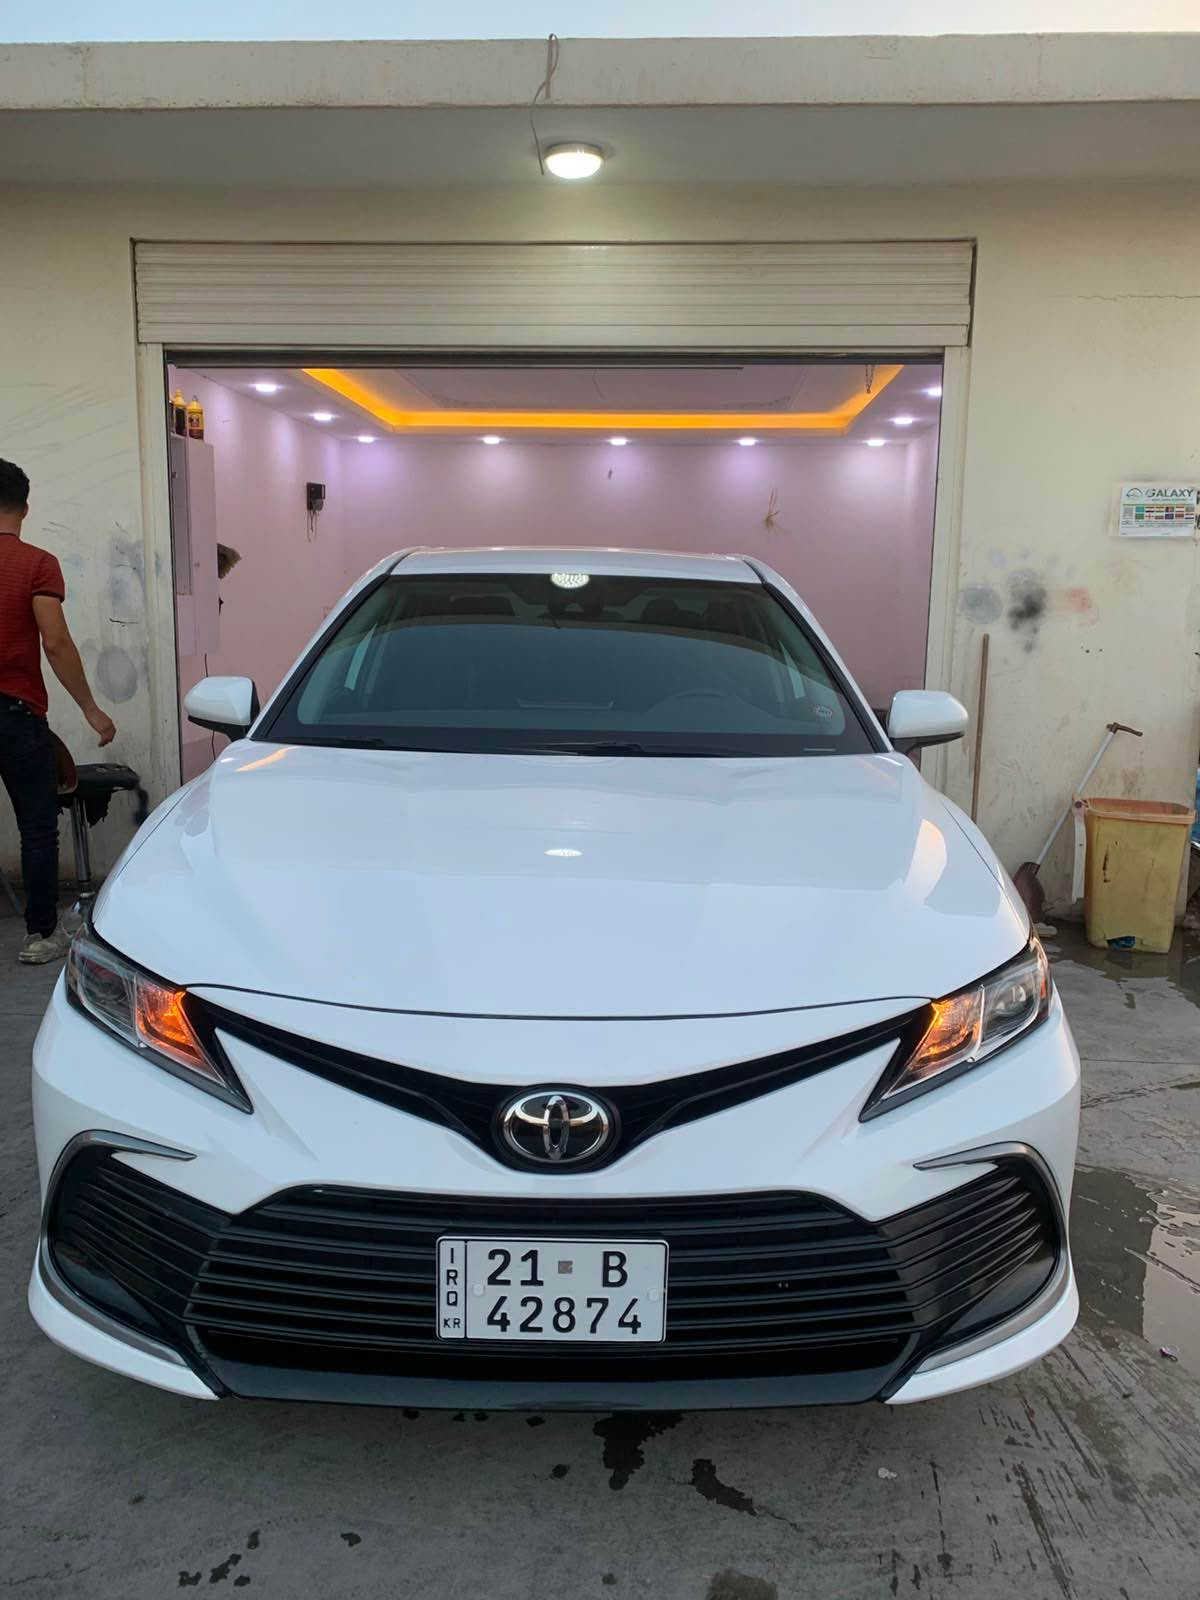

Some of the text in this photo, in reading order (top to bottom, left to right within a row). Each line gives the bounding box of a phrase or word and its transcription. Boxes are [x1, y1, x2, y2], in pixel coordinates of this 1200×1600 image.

[1145, 488, 1194, 498] GALAXY
[445, 1247, 459, 1307] IRQ
[487, 1248, 628, 1288] 21 B
[443, 1317, 461, 1329] KR
[486, 1295, 642, 1335] 42874
